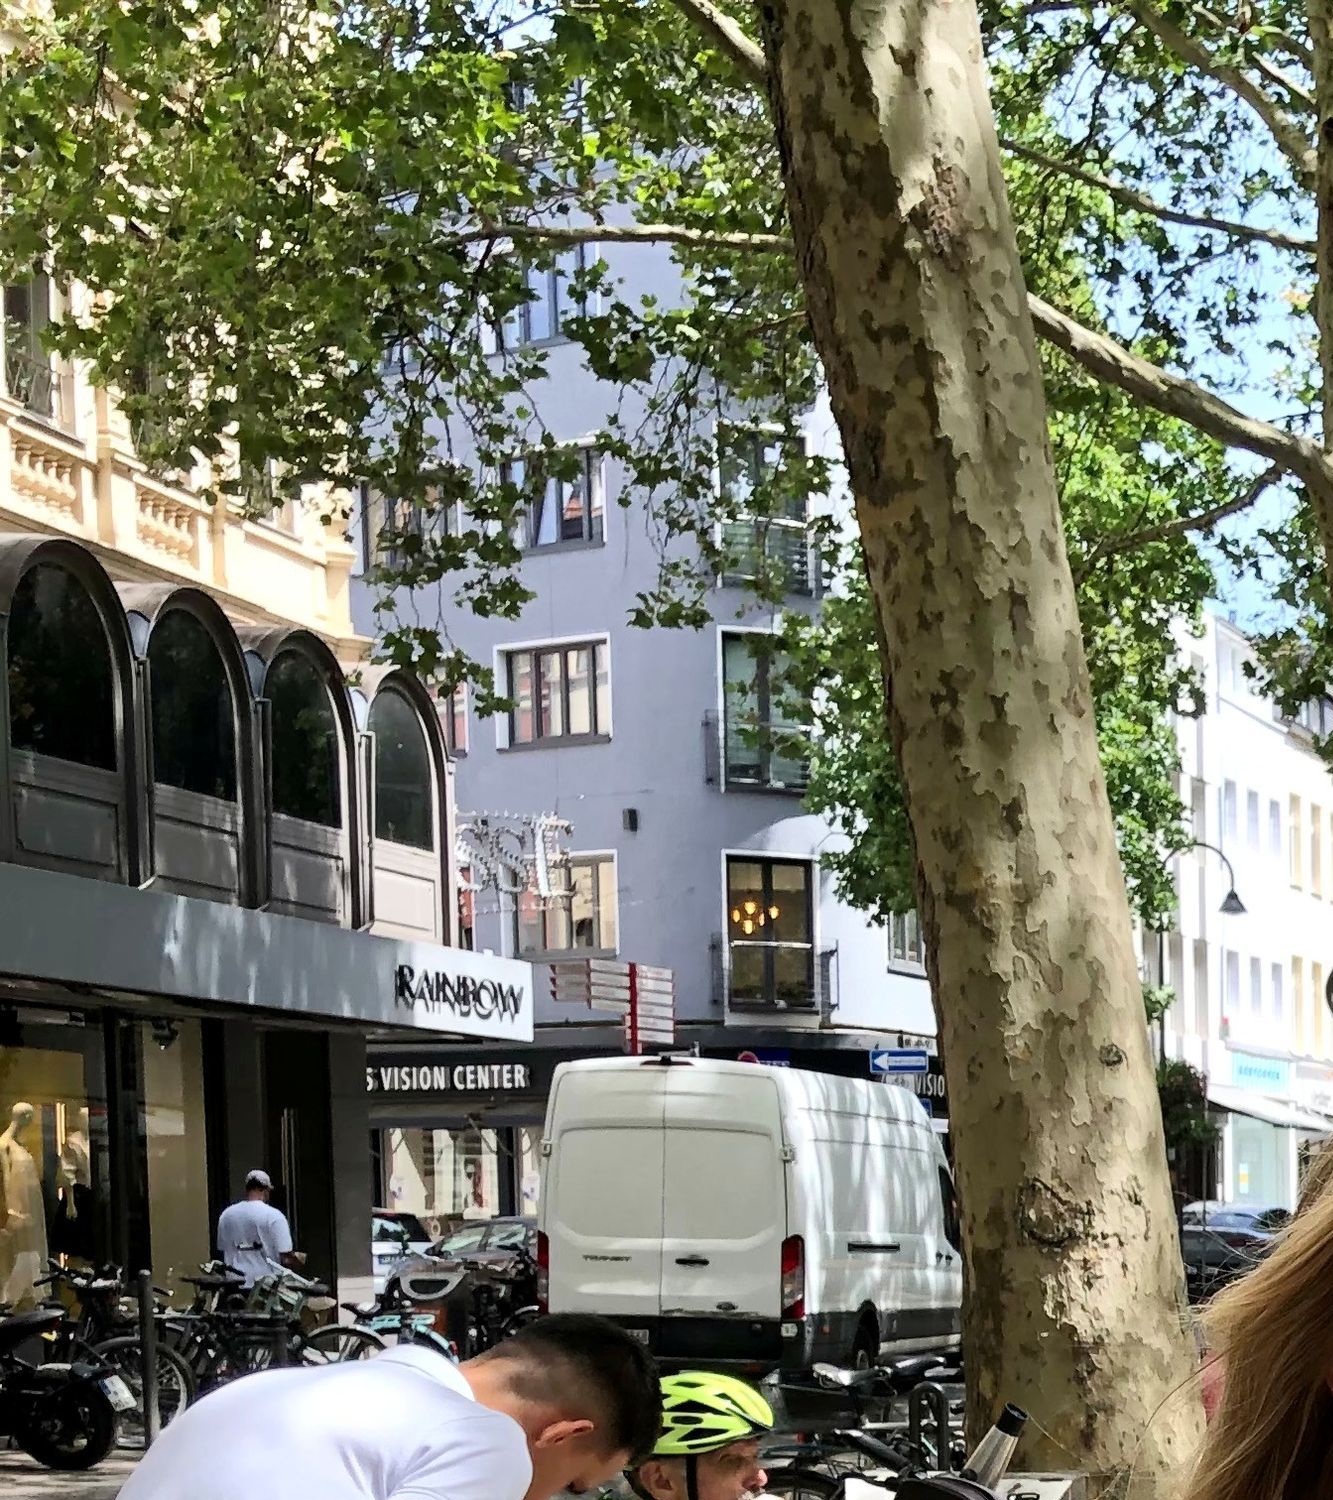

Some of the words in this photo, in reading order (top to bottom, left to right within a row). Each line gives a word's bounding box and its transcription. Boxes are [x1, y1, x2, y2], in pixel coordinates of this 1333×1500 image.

[394, 964, 524, 1022] RAINBOW
[380, 1065, 446, 1091] VISION
[453, 1064, 527, 1090] CENTER
[914, 1073, 946, 1098] VISIO
